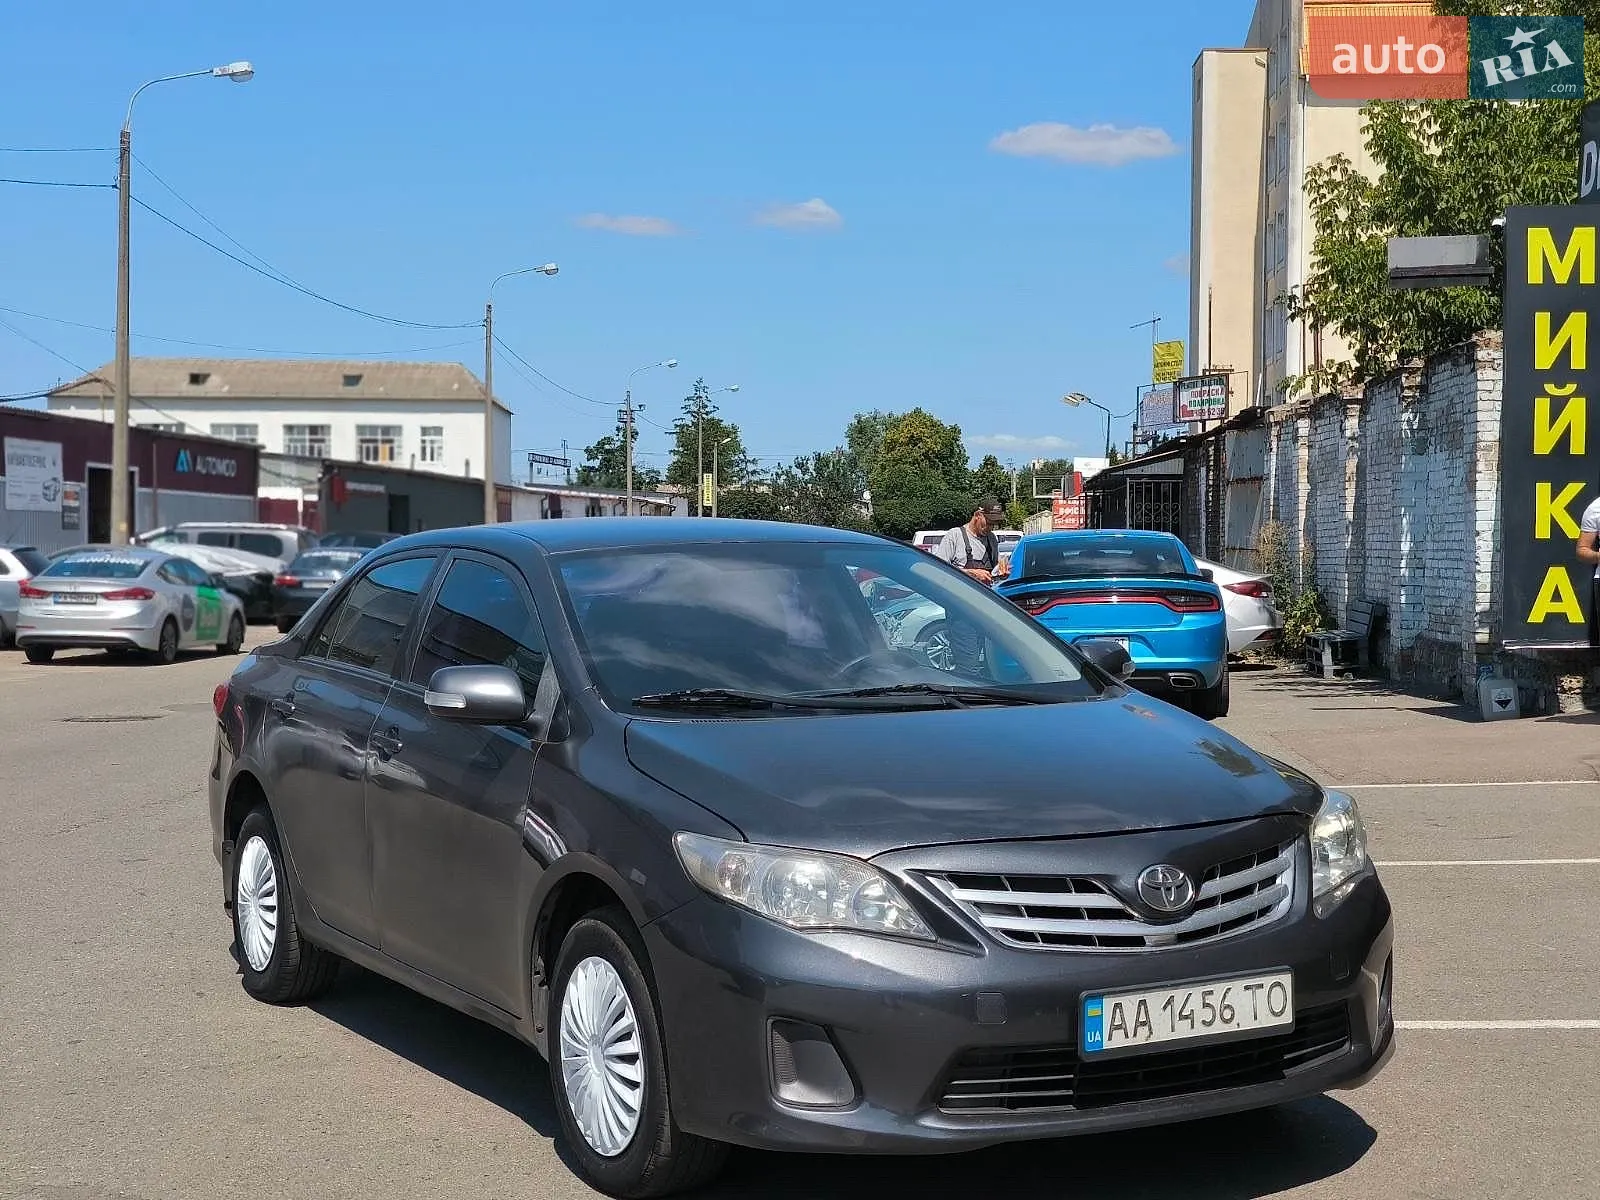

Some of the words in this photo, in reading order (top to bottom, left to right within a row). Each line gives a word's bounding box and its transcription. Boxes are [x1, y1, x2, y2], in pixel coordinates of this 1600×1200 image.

[1581, 141, 1600, 198] D
[1526, 226, 1596, 623] МИЙКА
[1087, 1029, 1102, 1043] UA
[1107, 998, 1154, 1042] AA
[1160, 986, 1236, 1034] 1456
[1243, 980, 1289, 1022] TO
